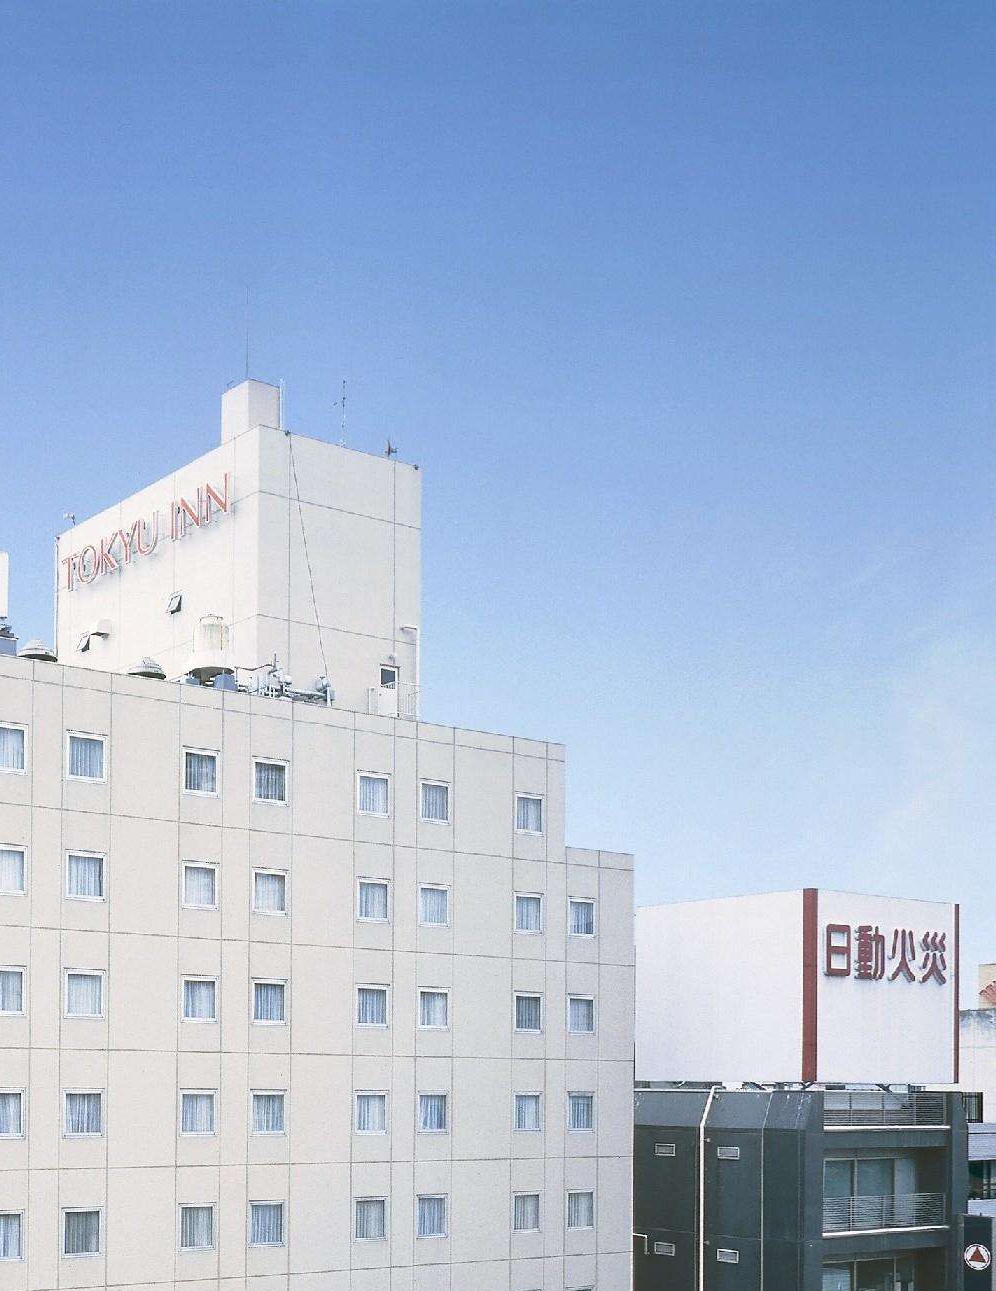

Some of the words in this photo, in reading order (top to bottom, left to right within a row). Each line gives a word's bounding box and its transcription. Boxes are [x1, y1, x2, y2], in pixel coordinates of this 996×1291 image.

[61, 511, 159, 592] TOKYU
[168, 472, 231, 542] INN
[825, 923, 946, 985] 日動火災
